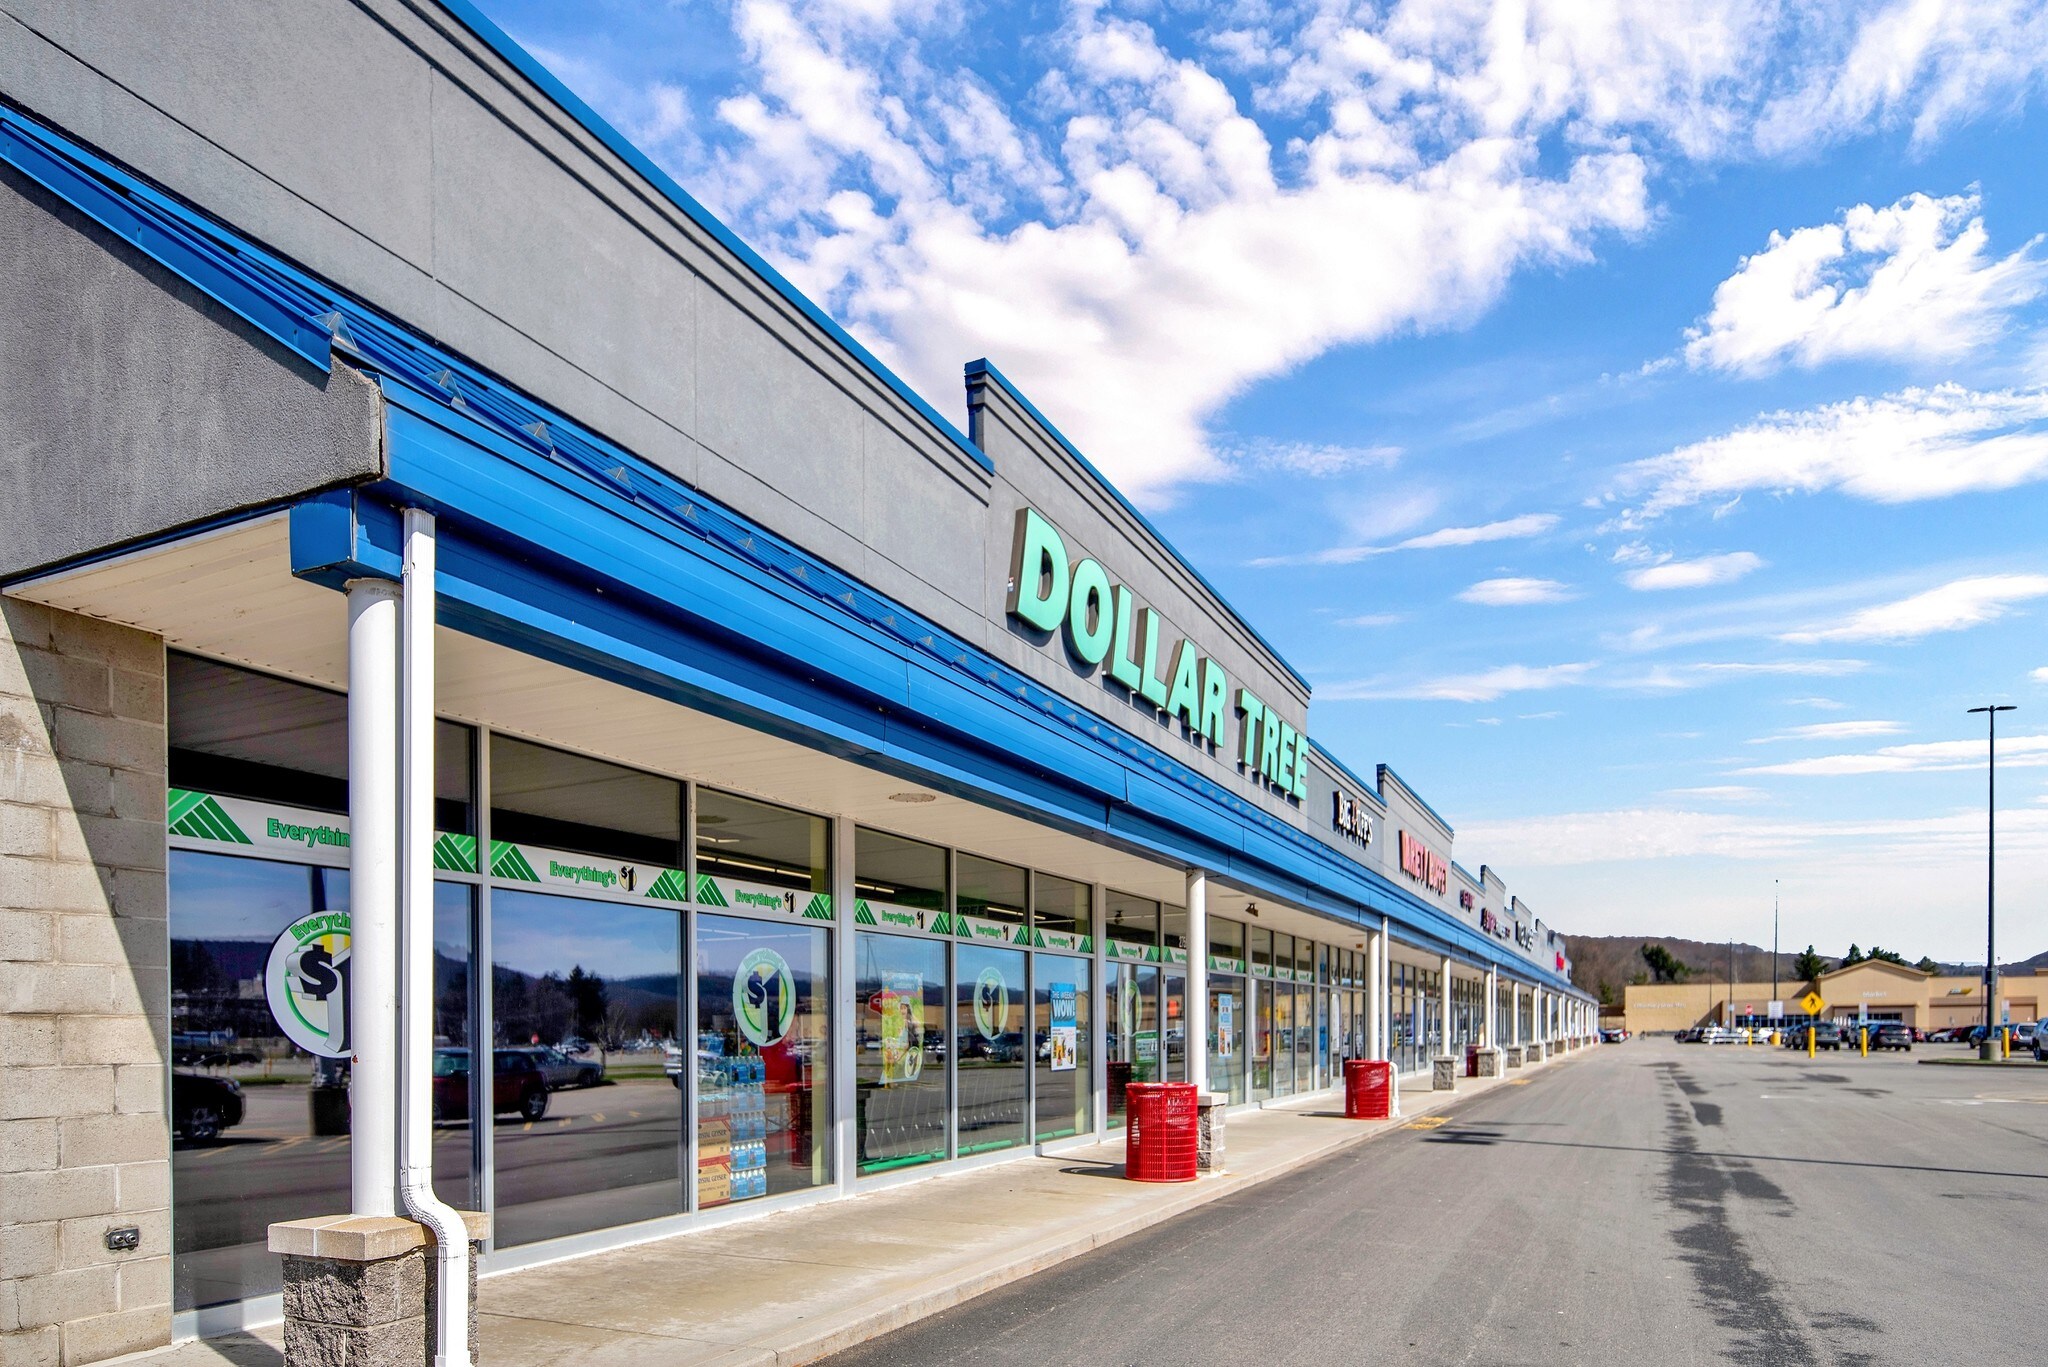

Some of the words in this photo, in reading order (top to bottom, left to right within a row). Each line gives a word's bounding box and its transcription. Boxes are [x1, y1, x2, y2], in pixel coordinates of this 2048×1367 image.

[1008, 507, 1228, 748] DOLLAR
[1235, 688, 1310, 801] TREE
[267, 817, 350, 848] Everythin
[549, 861, 617, 888] Everything's
[620, 865, 635, 892] $1
[734, 889, 783, 910] Everything's
[784, 892, 796, 914] $1
[289, 912, 350, 941] Everyth
[1052, 999, 1076, 1020] WOW!
